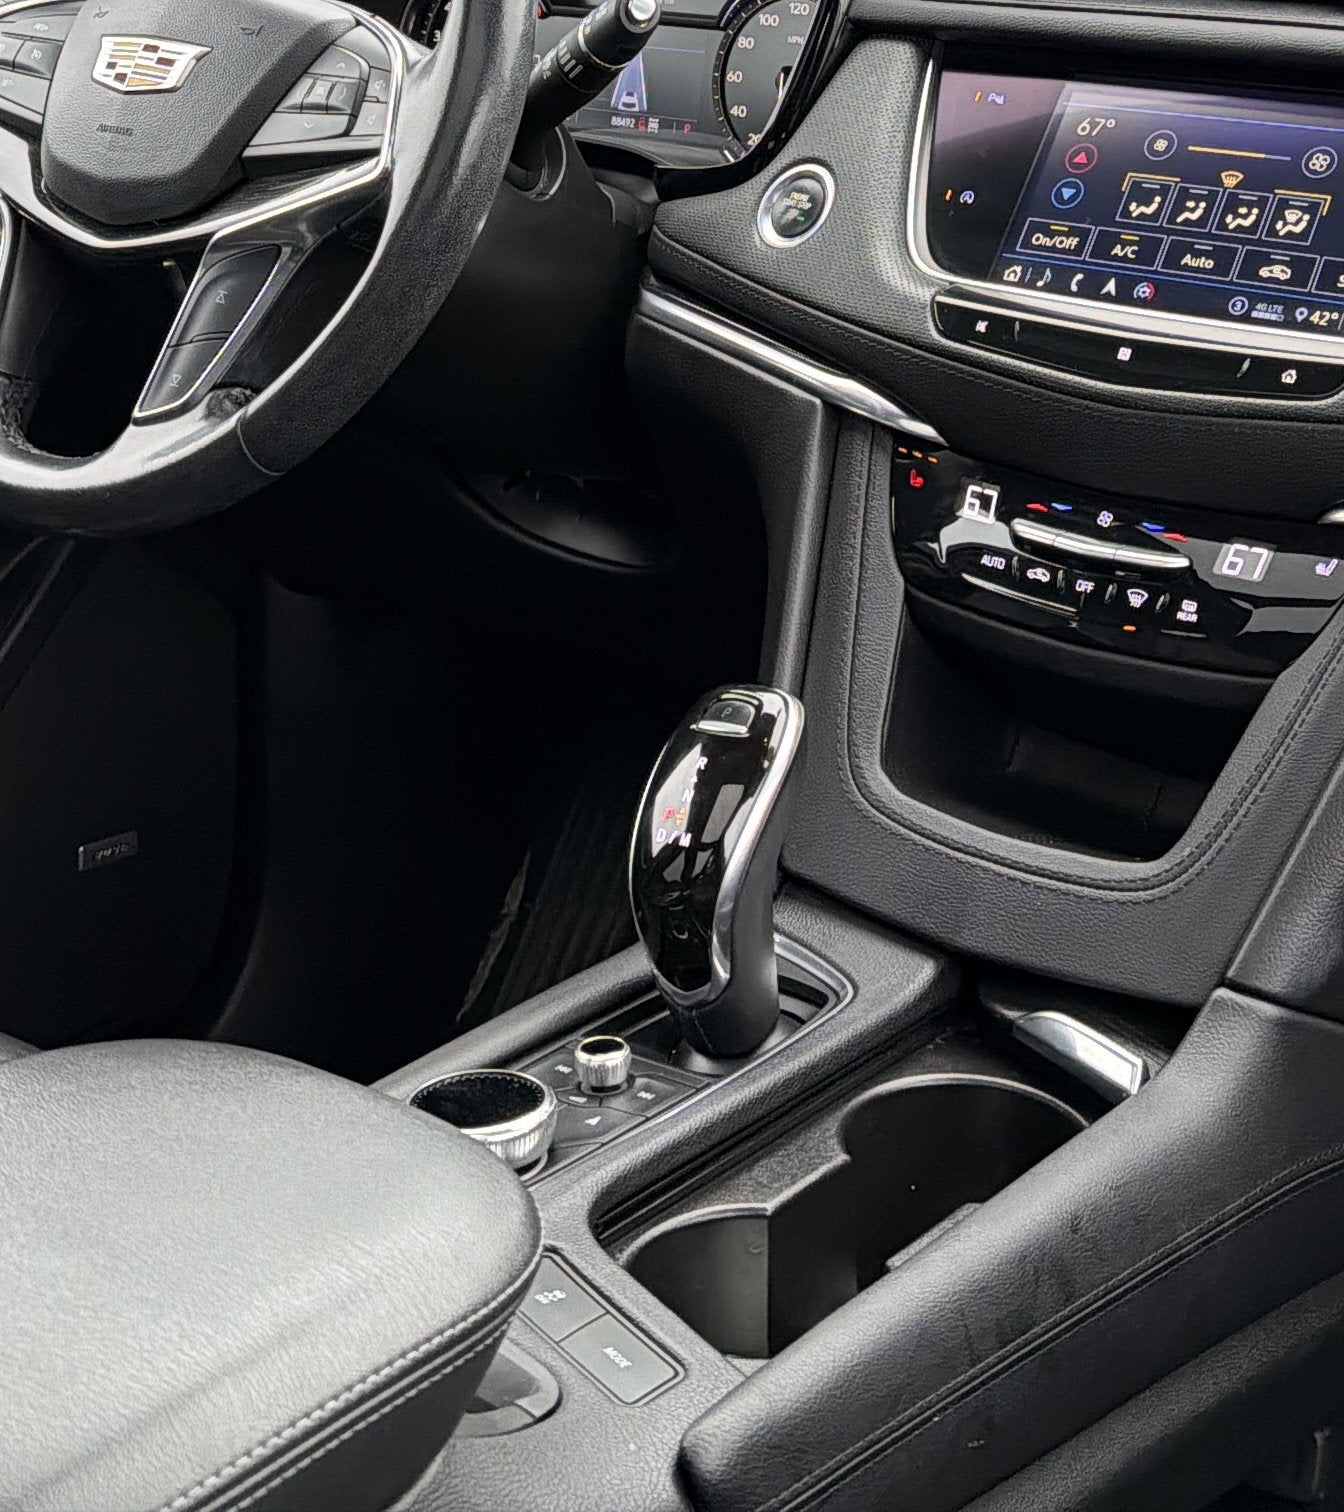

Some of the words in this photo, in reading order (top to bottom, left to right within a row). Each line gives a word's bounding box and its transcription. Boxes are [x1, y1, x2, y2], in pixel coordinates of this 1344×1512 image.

[788, 1, 811, 16] 120
[758, 13, 780, 27] 100
[737, 37, 755, 50] 80
[726, 70, 743, 83] 60
[729, 104, 747, 118] 40
[1031, 232, 1081, 250] On/Off
[1110, 243, 1140, 259] A/C
[1180, 253, 1215, 270] Auto
[962, 484, 999, 526] 67
[980, 553, 1006, 571] AUTO
[1221, 543, 1272, 580] 67
[1075, 579, 1096, 594] OFF
[720, 706, 733, 718] P
[695, 756, 709, 771] R
[681, 789, 695, 803] N
[602, 1346, 633, 1369] MODE
